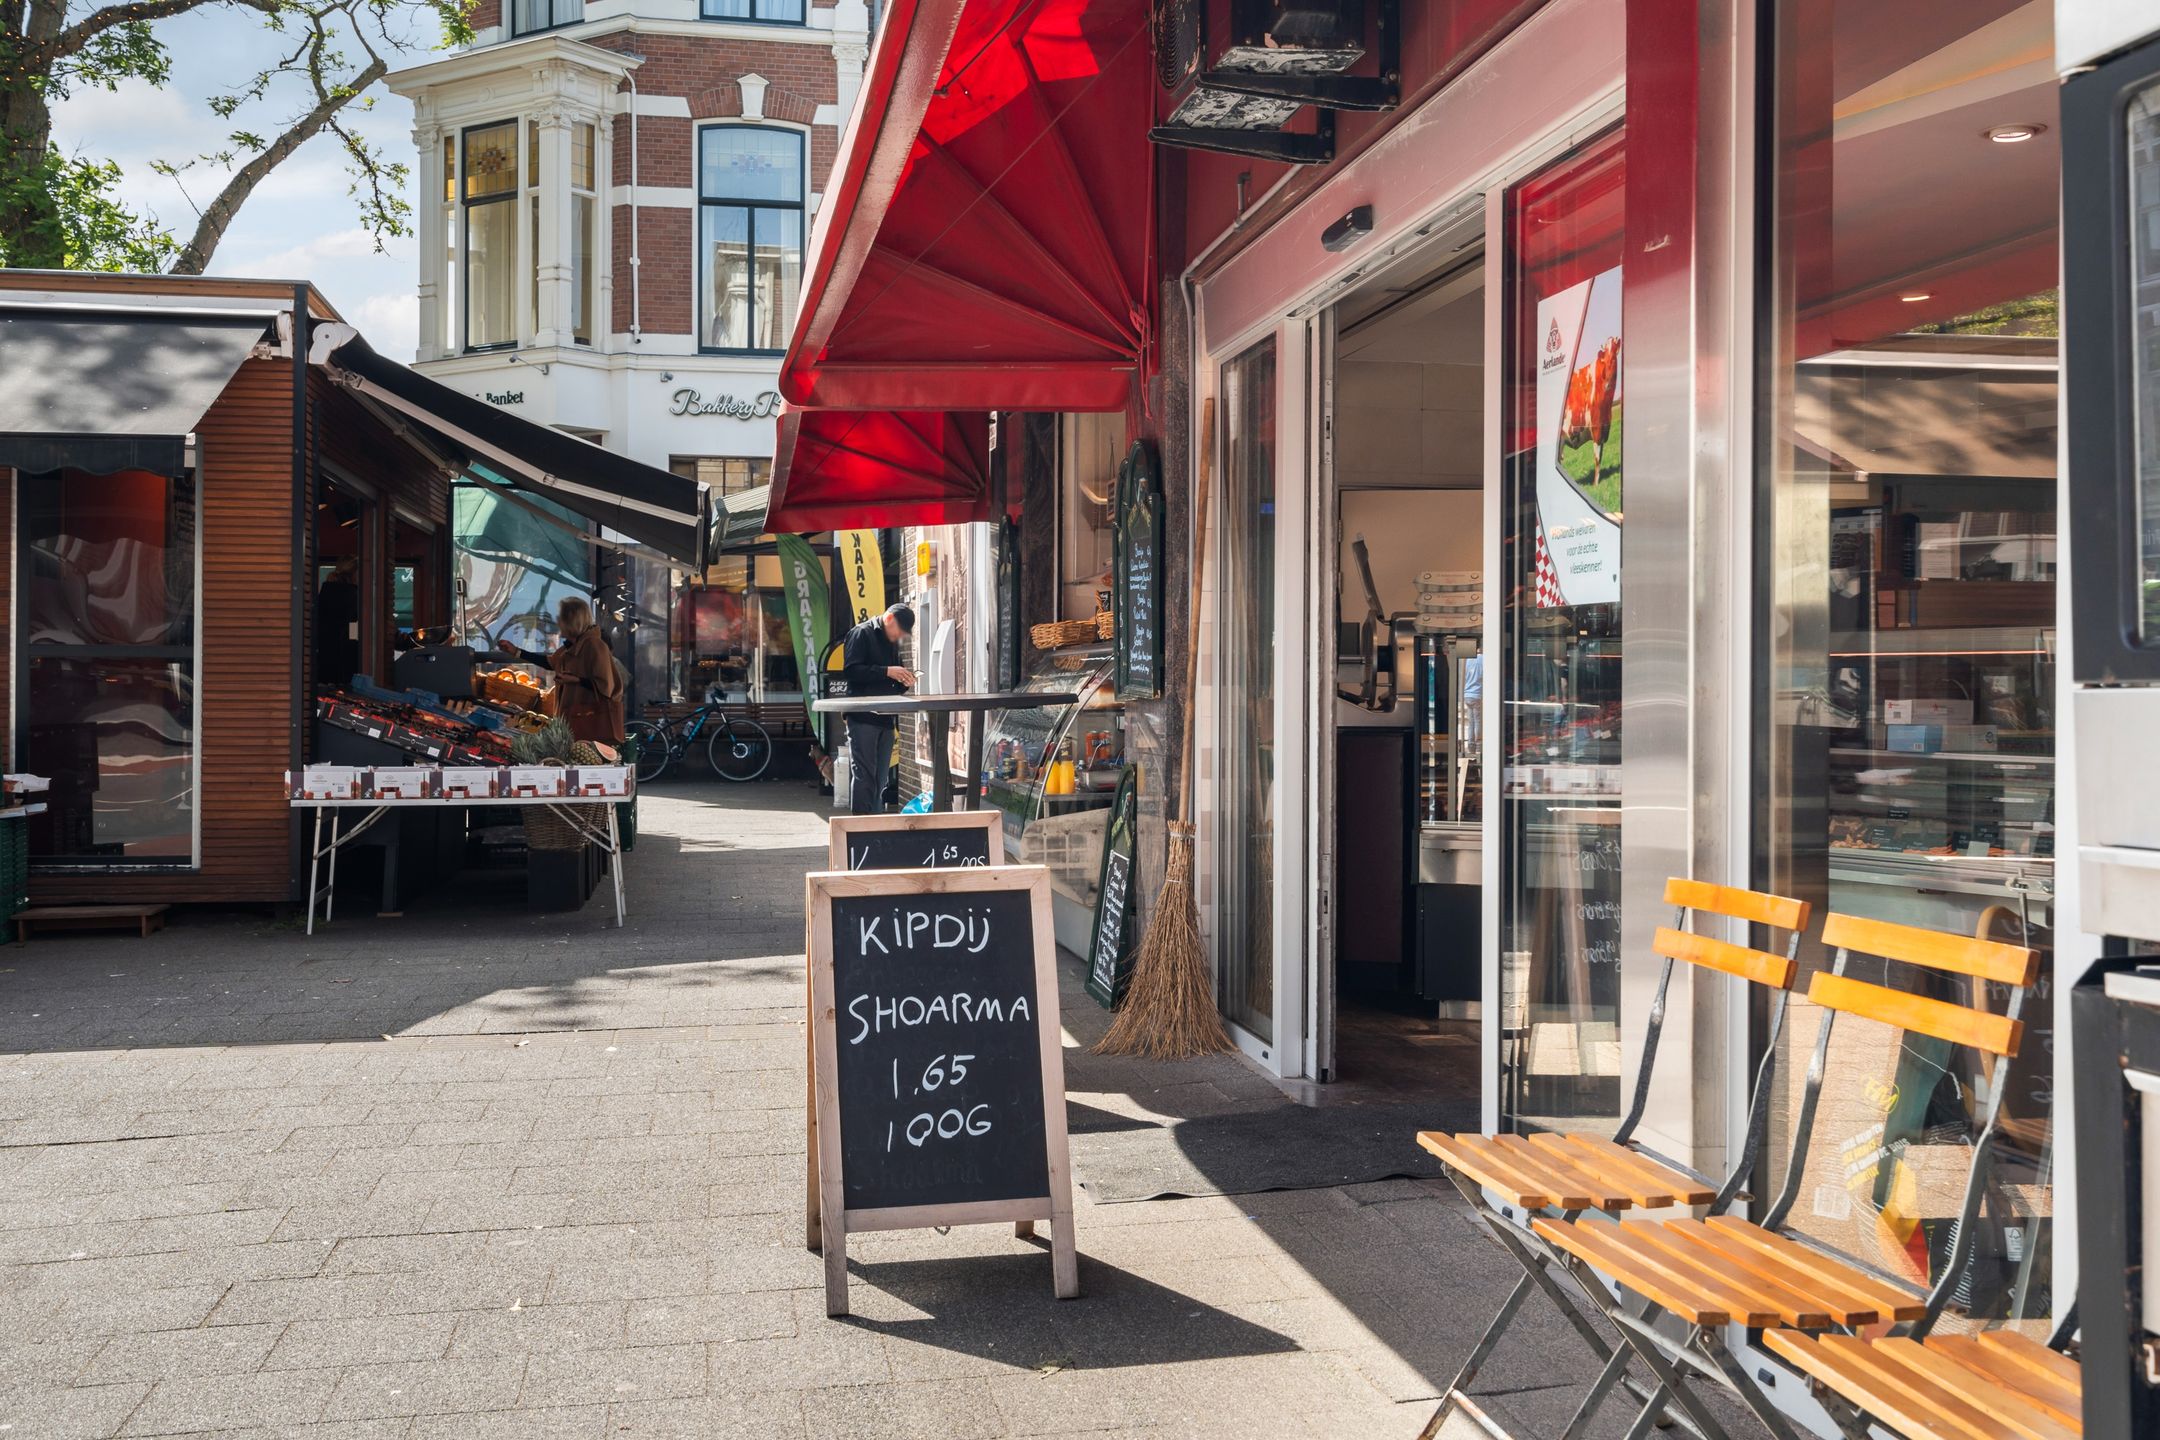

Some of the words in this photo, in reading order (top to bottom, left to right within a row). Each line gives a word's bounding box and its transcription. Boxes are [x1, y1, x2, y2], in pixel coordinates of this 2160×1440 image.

[486, 390, 524, 405] Banket
[848, 992, 1031, 1045] SHOARMA
[886, 1103, 993, 1153] 100G
